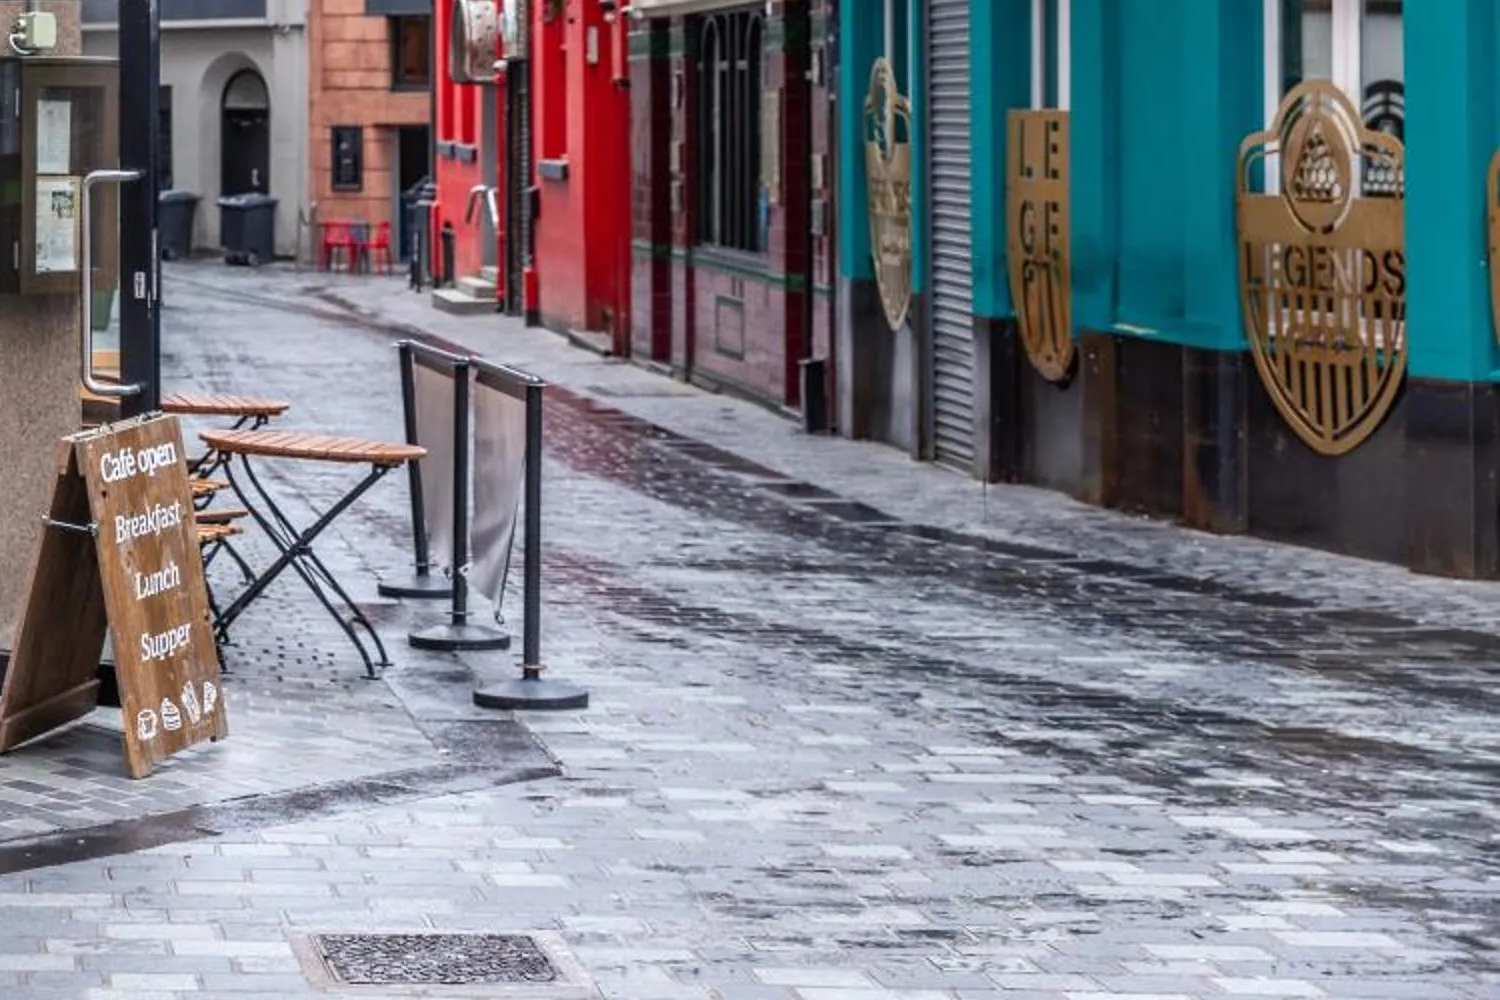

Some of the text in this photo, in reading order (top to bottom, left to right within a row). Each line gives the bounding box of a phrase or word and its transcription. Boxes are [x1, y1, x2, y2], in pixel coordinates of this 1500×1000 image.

[1246, 242, 1405, 296] LEGENDS
[101, 441, 177, 483] Café open
[115, 501, 181, 544] Breakfast
[134, 560, 181, 600] Lunch
[141, 623, 191, 662] Supper
